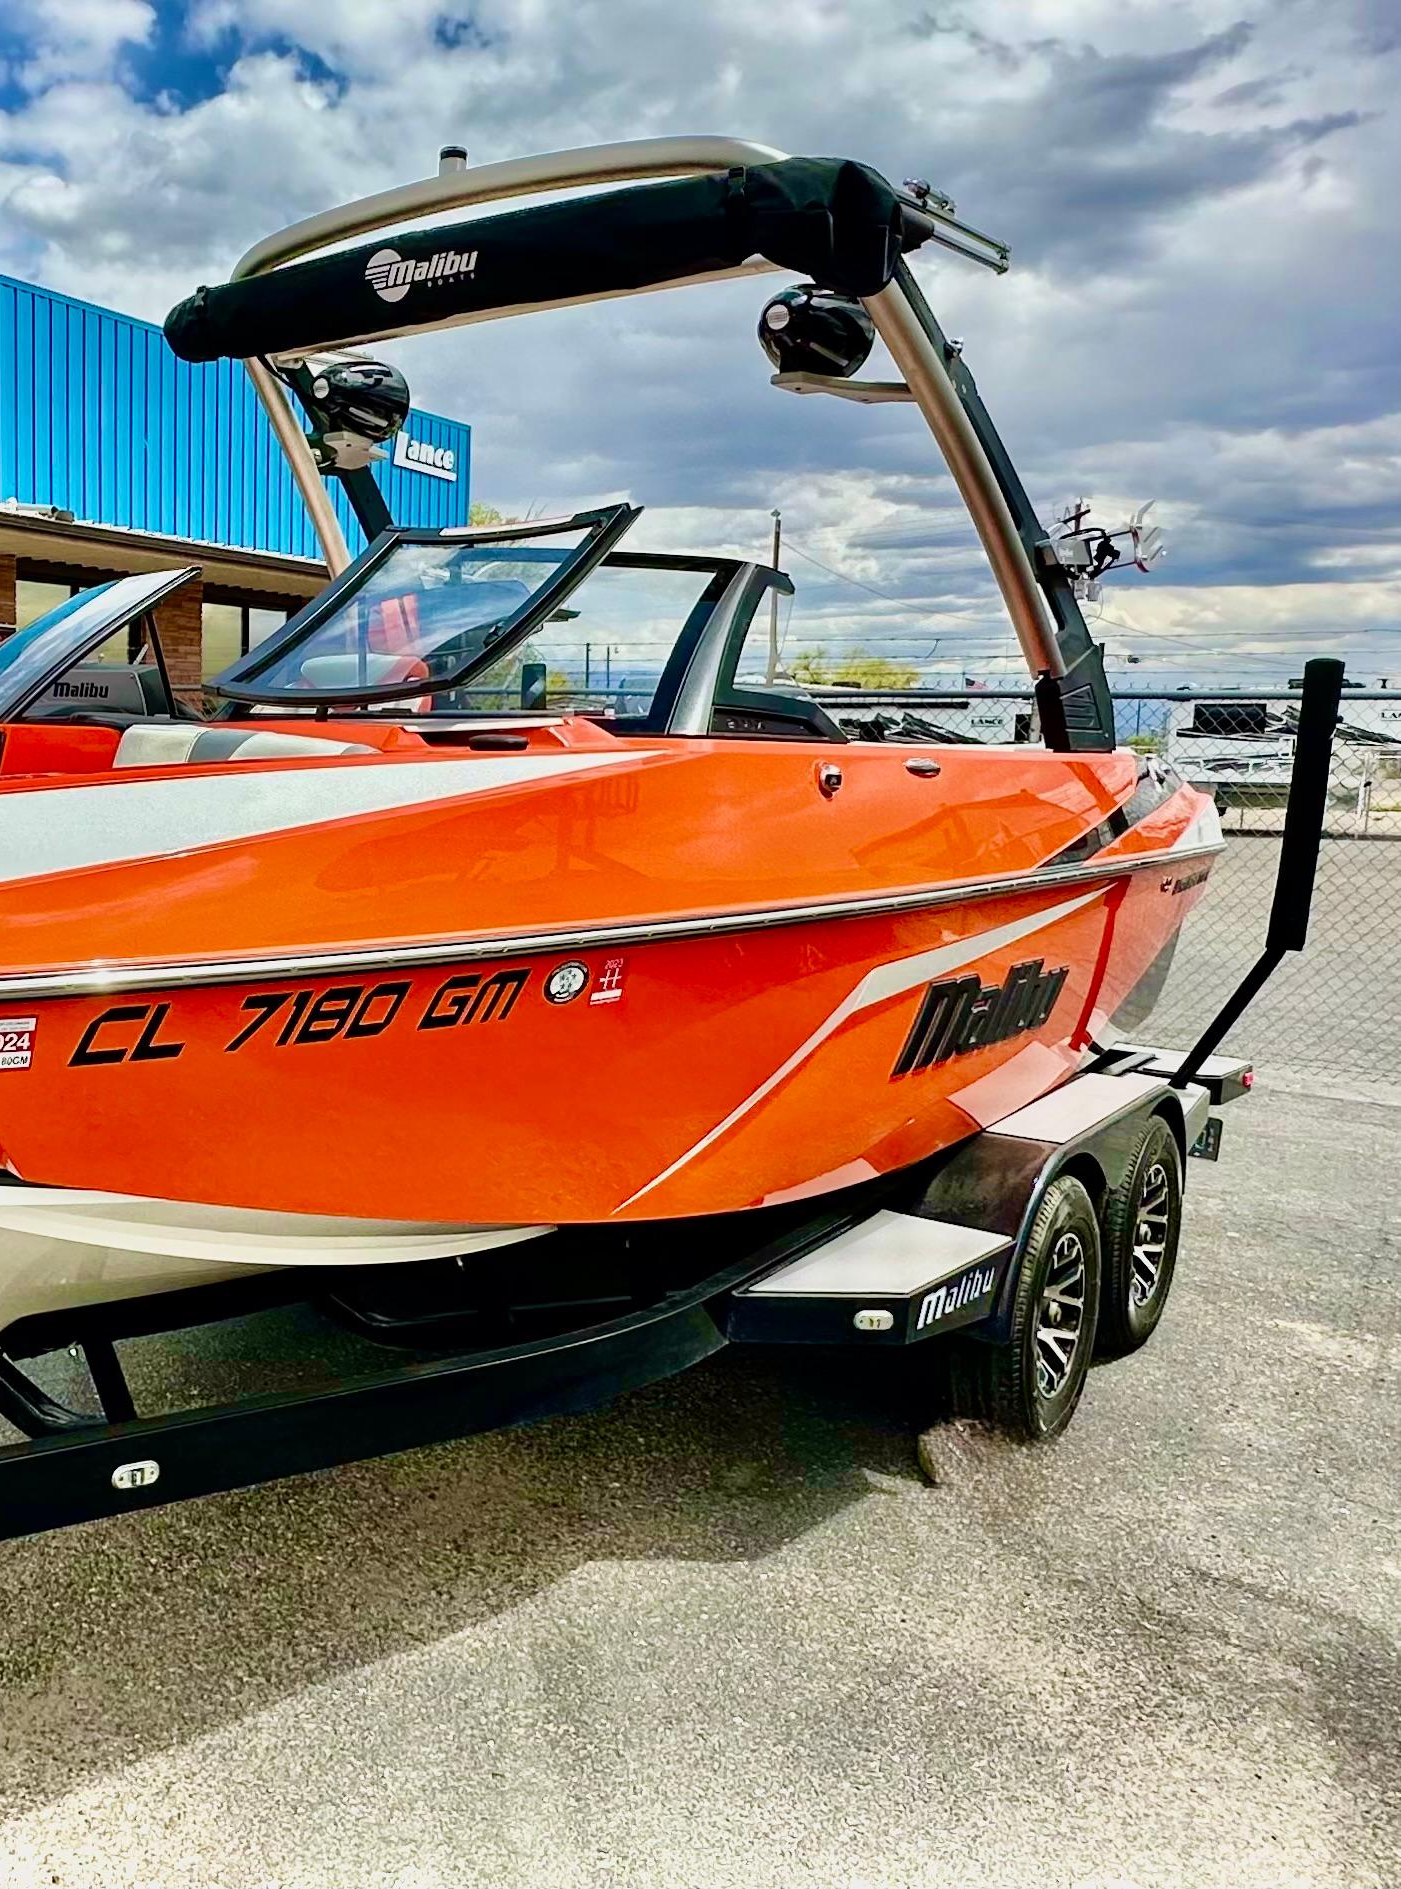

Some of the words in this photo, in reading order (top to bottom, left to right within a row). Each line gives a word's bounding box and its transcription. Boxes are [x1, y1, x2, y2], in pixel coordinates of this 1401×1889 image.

[387, 250, 478, 287] Malibu
[393, 430, 457, 482] Lance
[53, 682, 109, 698] Malibu
[67, 1001, 187, 1067] CL
[224, 980, 414, 1053] 7180
[416, 967, 533, 1031] GM
[889, 957, 1071, 1079] Malibu
[916, 1266, 996, 1330] Malibu
